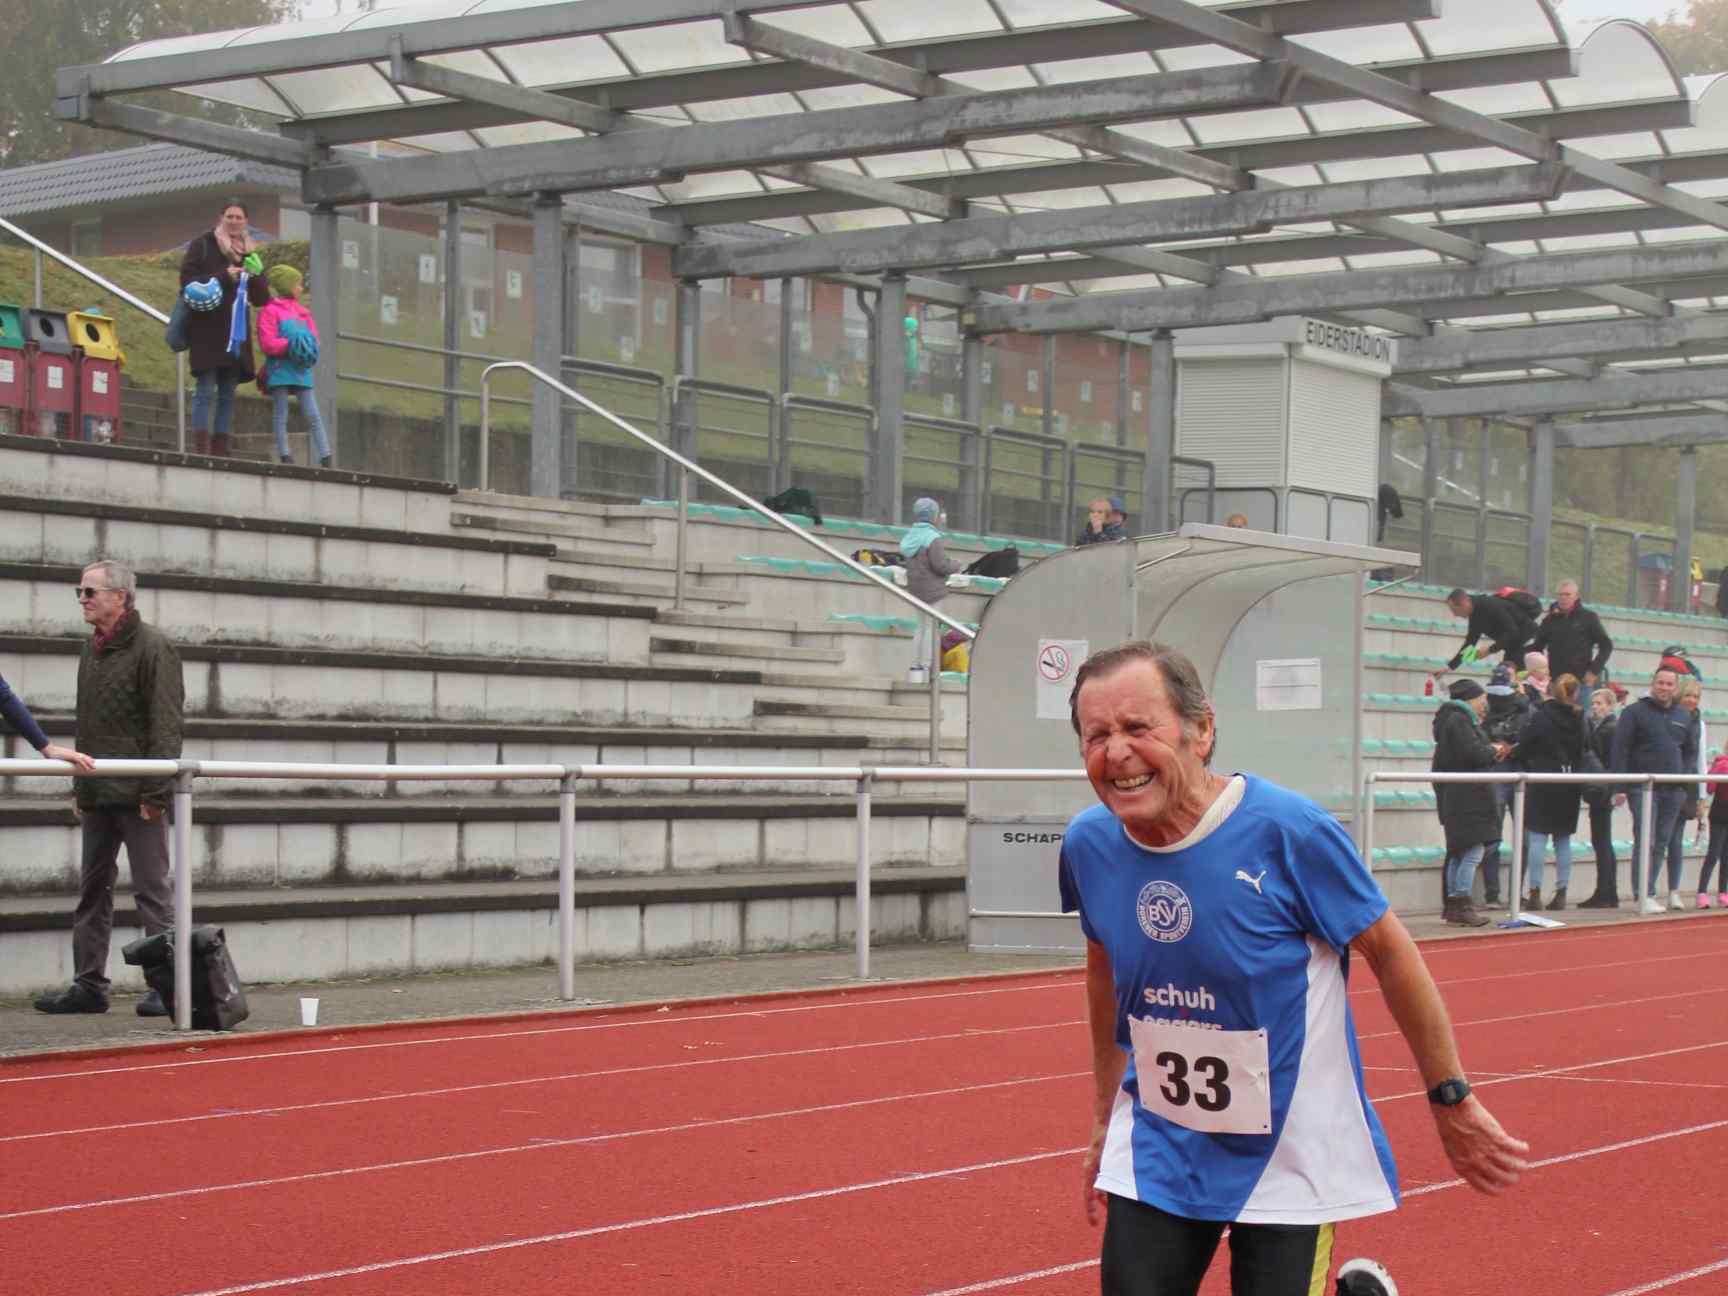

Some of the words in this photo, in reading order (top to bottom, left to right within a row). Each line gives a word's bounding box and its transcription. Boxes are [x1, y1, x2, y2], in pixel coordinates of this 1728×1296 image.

[1307, 321, 1390, 361] EIDERSTADION
[1149, 900, 1178, 927] BSV
[1143, 983, 1217, 1011] schuh
[1155, 1051, 1232, 1112] 33
